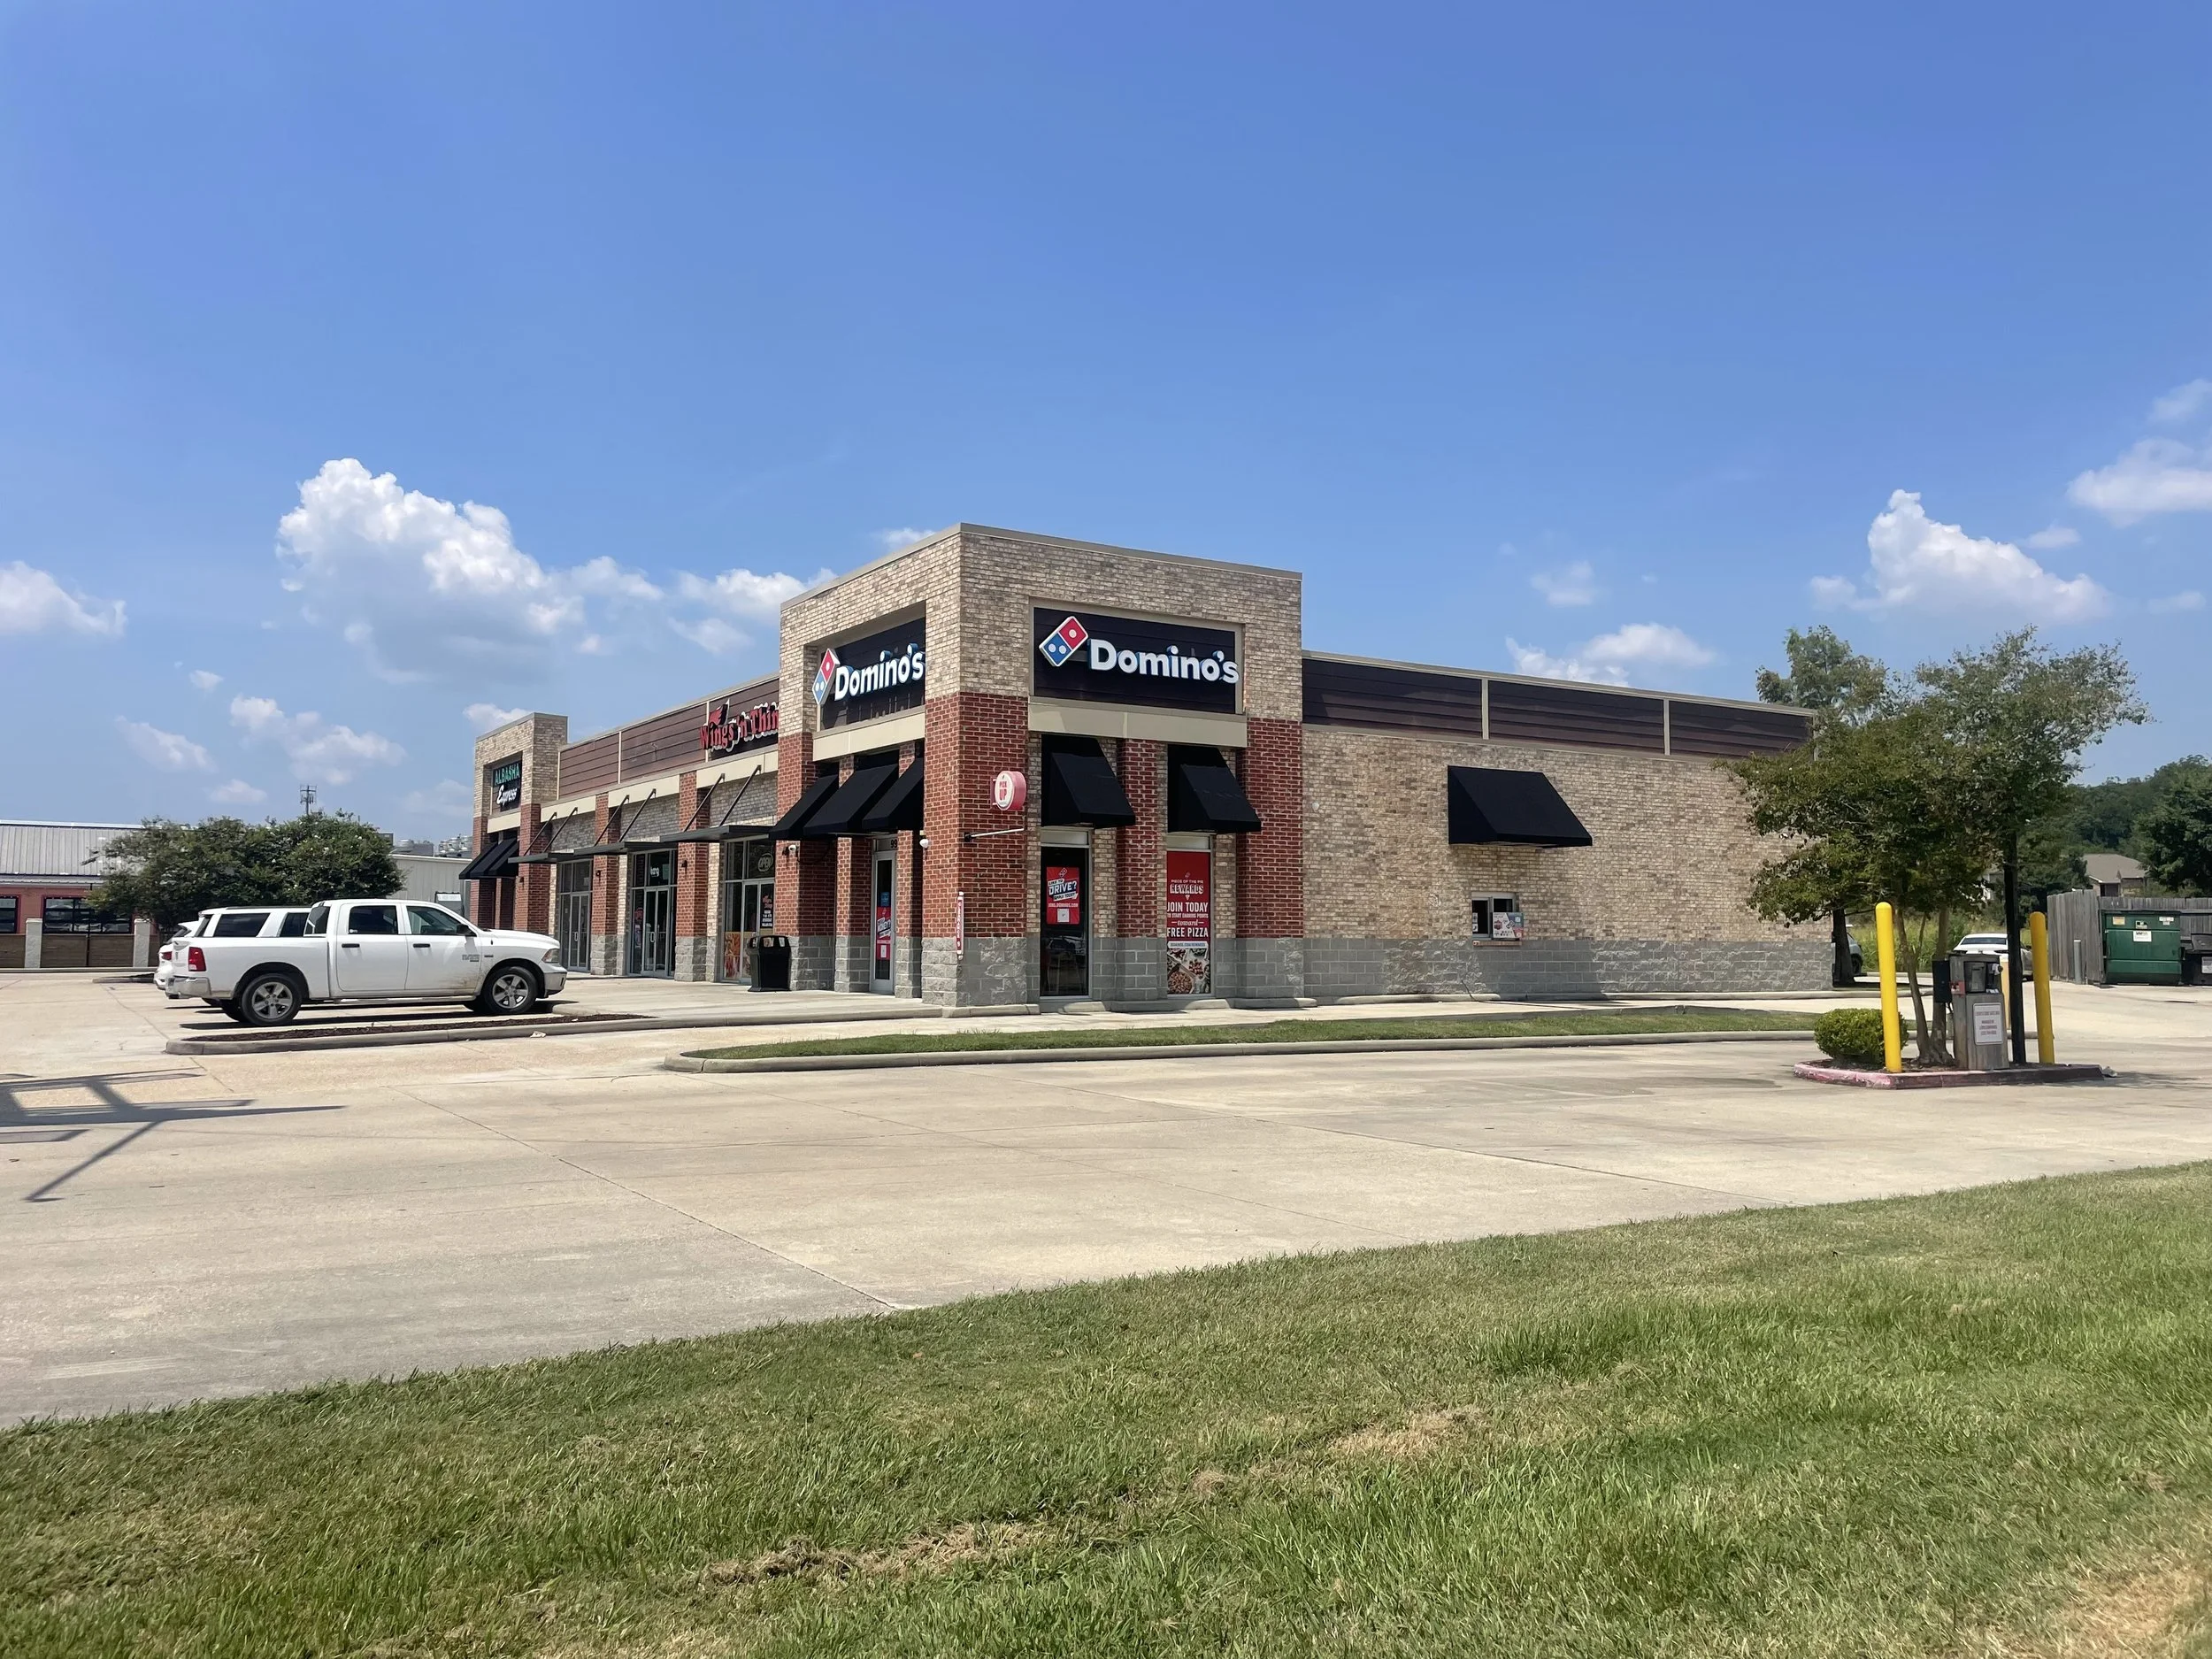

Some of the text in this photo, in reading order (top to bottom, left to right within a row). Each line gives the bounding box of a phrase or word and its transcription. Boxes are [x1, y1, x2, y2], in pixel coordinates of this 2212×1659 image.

[1088, 639, 1239, 684] Domino's
[834, 643, 924, 701] Domino's
[700, 722, 733, 749] Wings
[495, 763, 520, 785] ALBASHA
[1000, 788, 1007, 801] UP
[1048, 880, 1077, 895] DRIVE?
[1170, 884, 1203, 895] REWARDS
[1167, 902, 1209, 912] JOIN TODAY
[1167, 927, 1209, 937] FREE PIZZA
